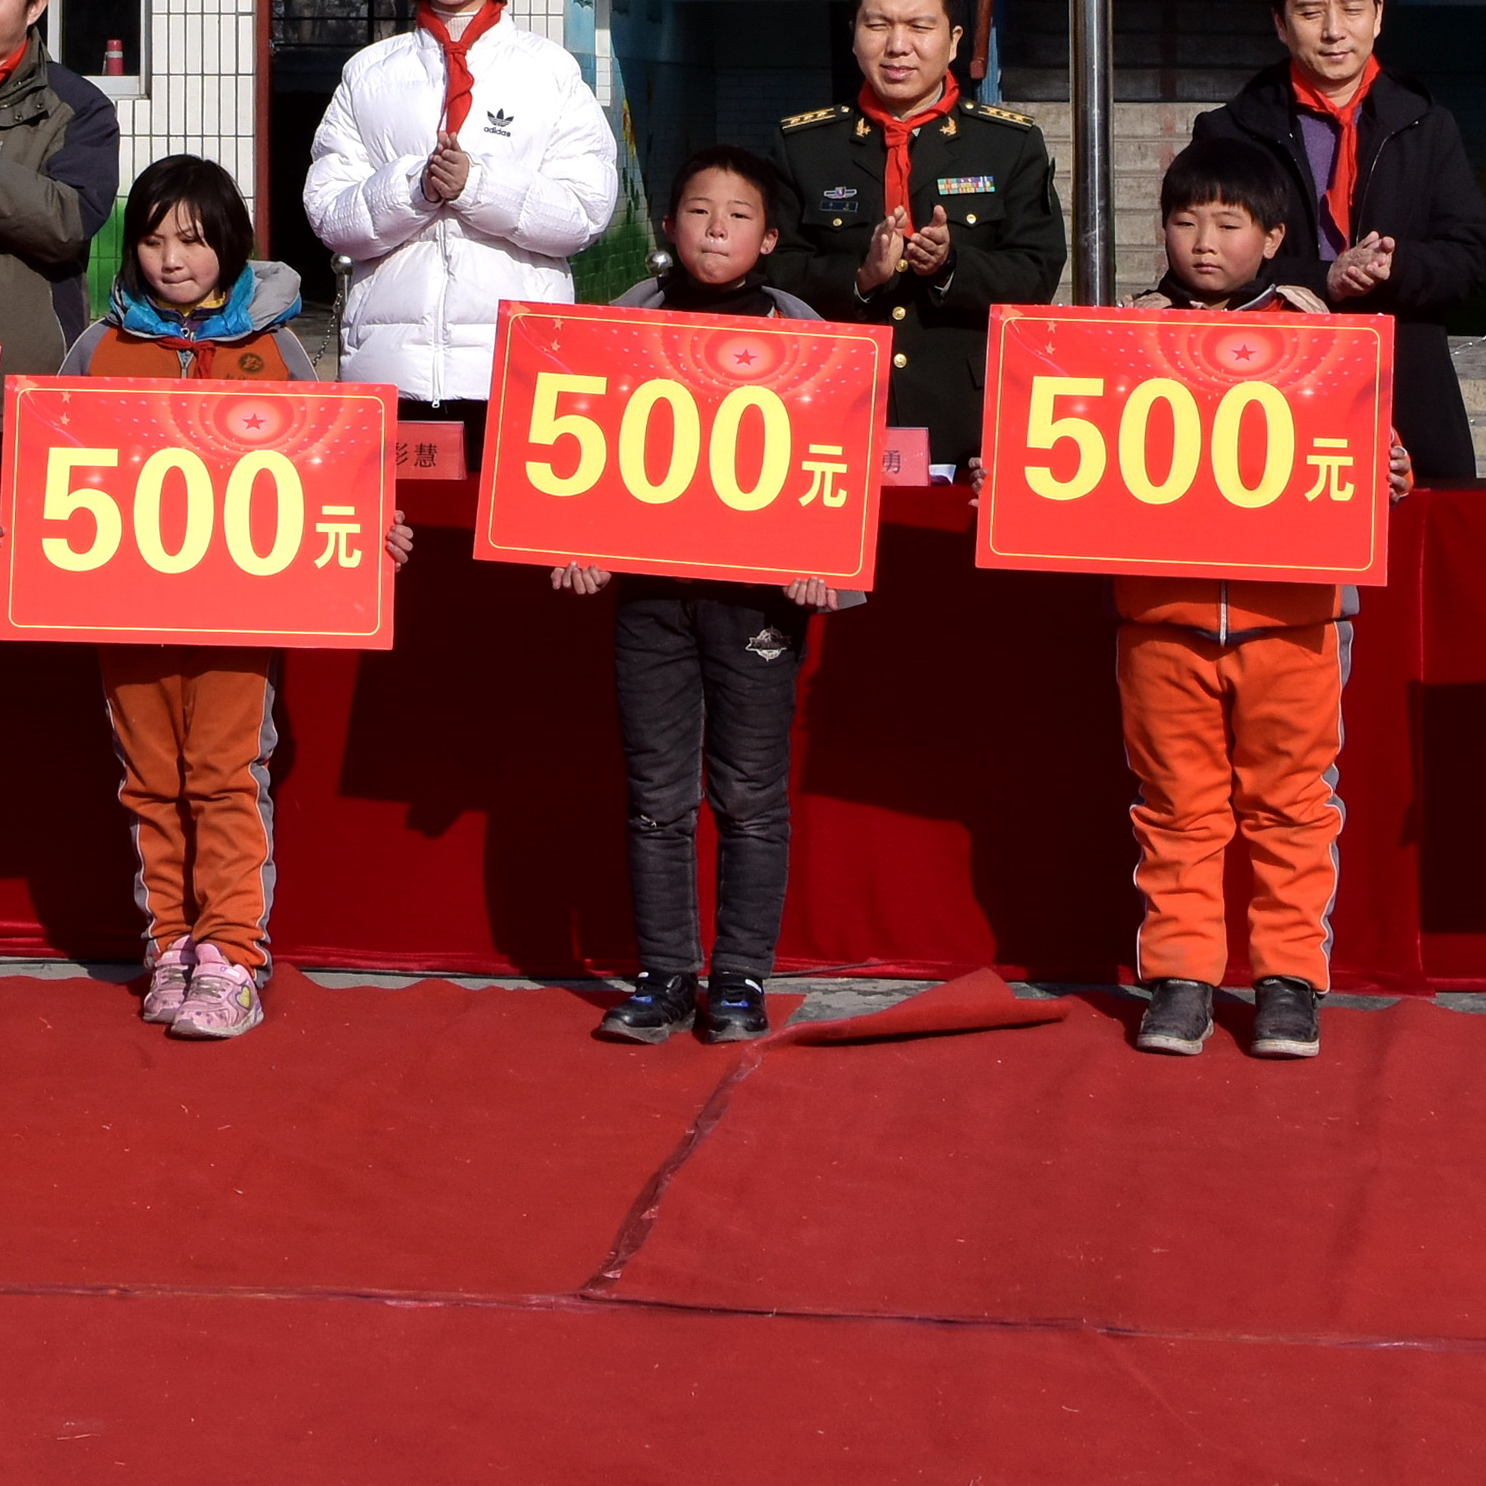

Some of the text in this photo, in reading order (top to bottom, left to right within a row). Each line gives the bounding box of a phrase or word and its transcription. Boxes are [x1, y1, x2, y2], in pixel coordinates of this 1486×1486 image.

[483, 126, 511, 137] adidas
[525, 372, 847, 511] 500元
[1024, 376, 1355, 509] 500元
[41, 447, 362, 576] 500元
